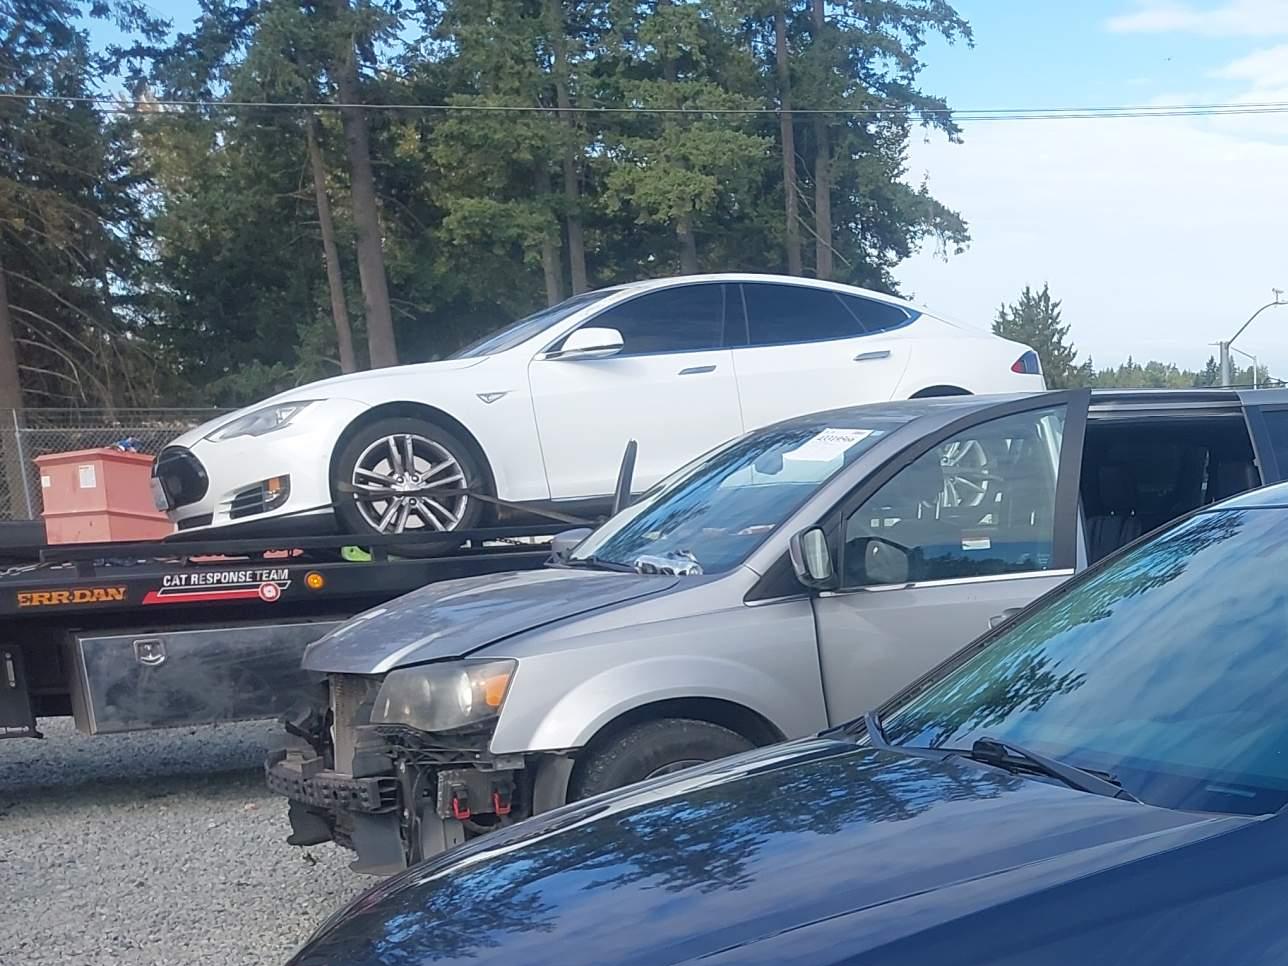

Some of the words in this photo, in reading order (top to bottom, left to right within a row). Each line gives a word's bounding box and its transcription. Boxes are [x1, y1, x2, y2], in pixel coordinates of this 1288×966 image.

[163, 574, 188, 586] CAT
[190, 571, 253, 585] RESPONSE
[254, 569, 289, 581] TEAM
